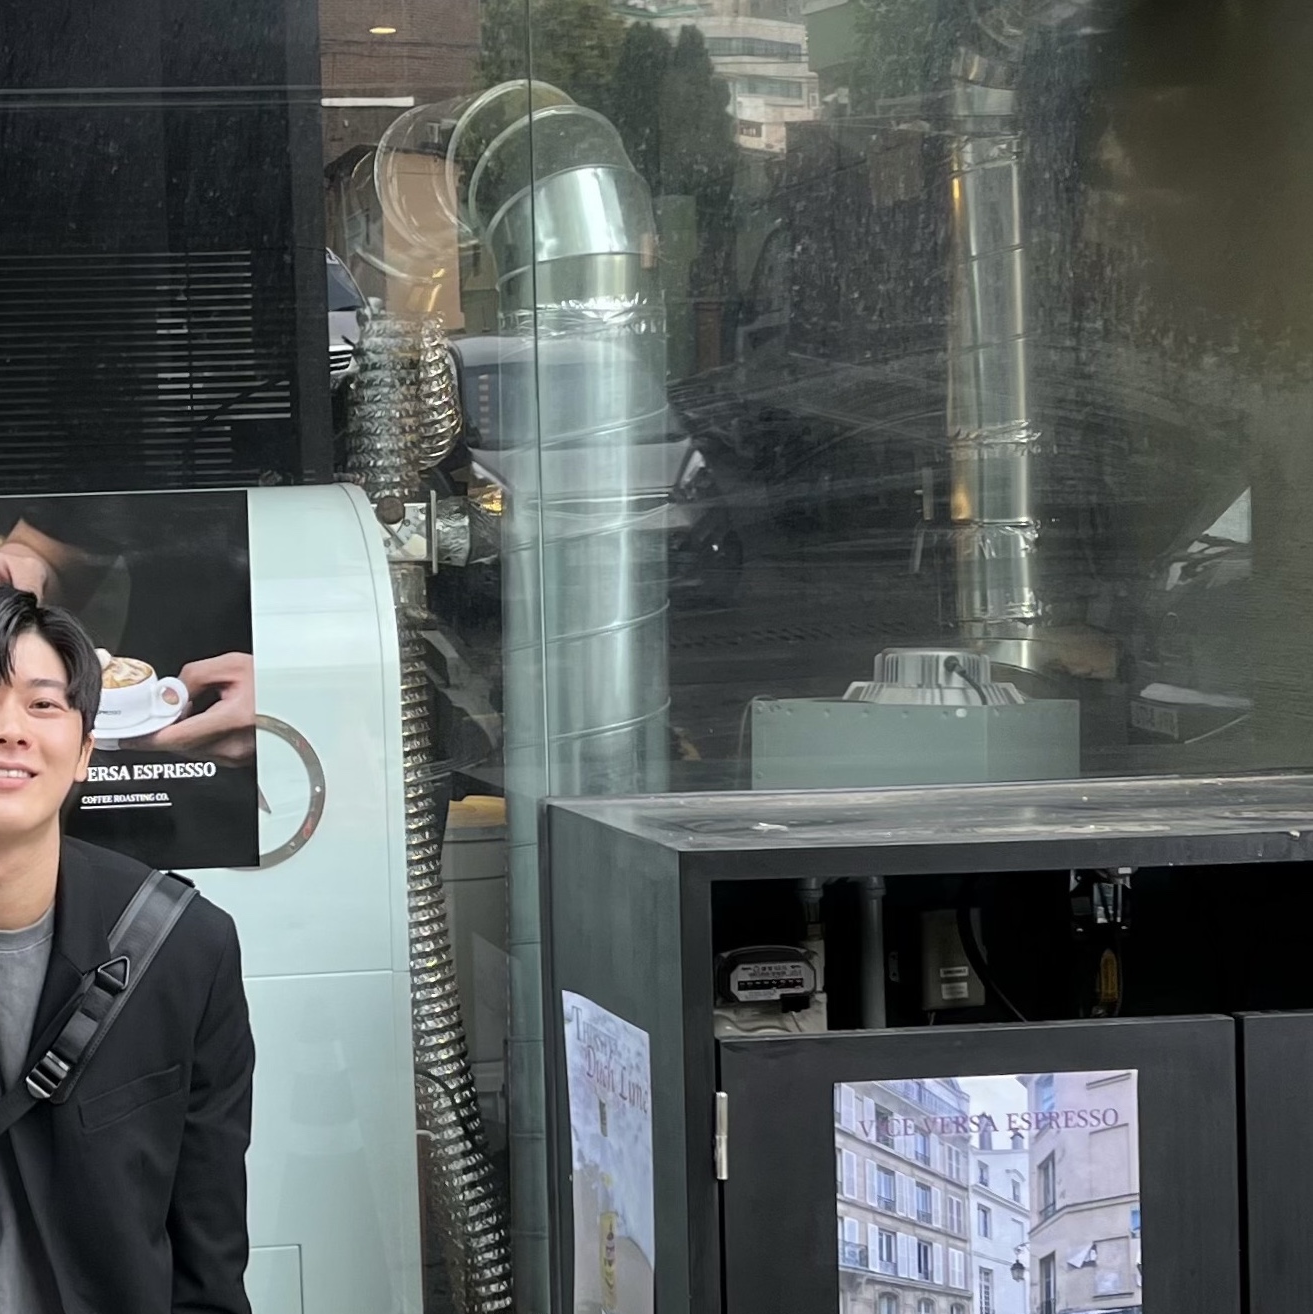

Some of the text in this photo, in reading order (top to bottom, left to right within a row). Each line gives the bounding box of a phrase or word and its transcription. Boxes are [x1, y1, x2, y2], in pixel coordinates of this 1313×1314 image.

[87, 761, 217, 782] ERSA ESPRESSO
[81, 792, 170, 805] COFFEE ROASTING CO.
[923, 1111, 999, 1136] VERSA
[1006, 1107, 1120, 1132] ESPRESSO
